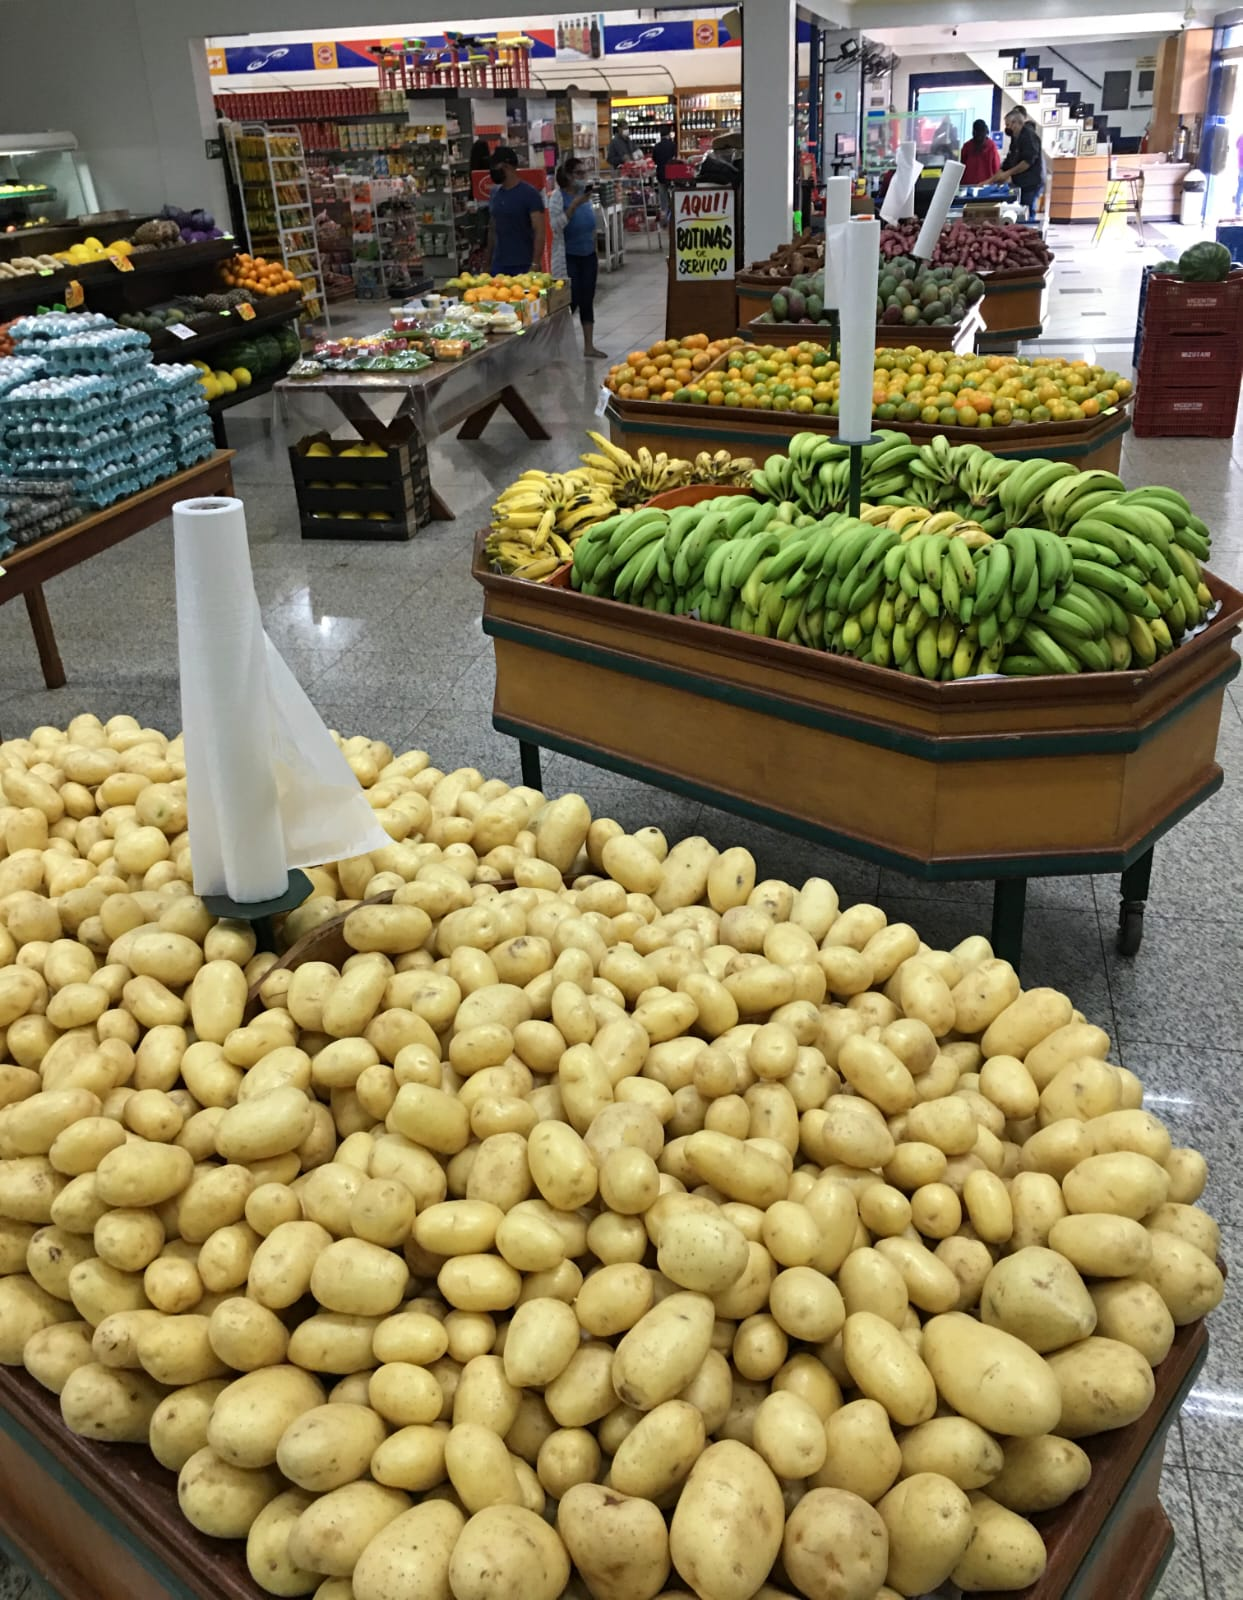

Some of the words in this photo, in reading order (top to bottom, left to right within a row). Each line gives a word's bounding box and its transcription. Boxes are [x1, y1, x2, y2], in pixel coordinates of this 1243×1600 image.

[680, 192, 728, 217] AQUI!
[676, 225, 732, 251] BOTINAS
[679, 258, 727, 275] SERVIÇO
